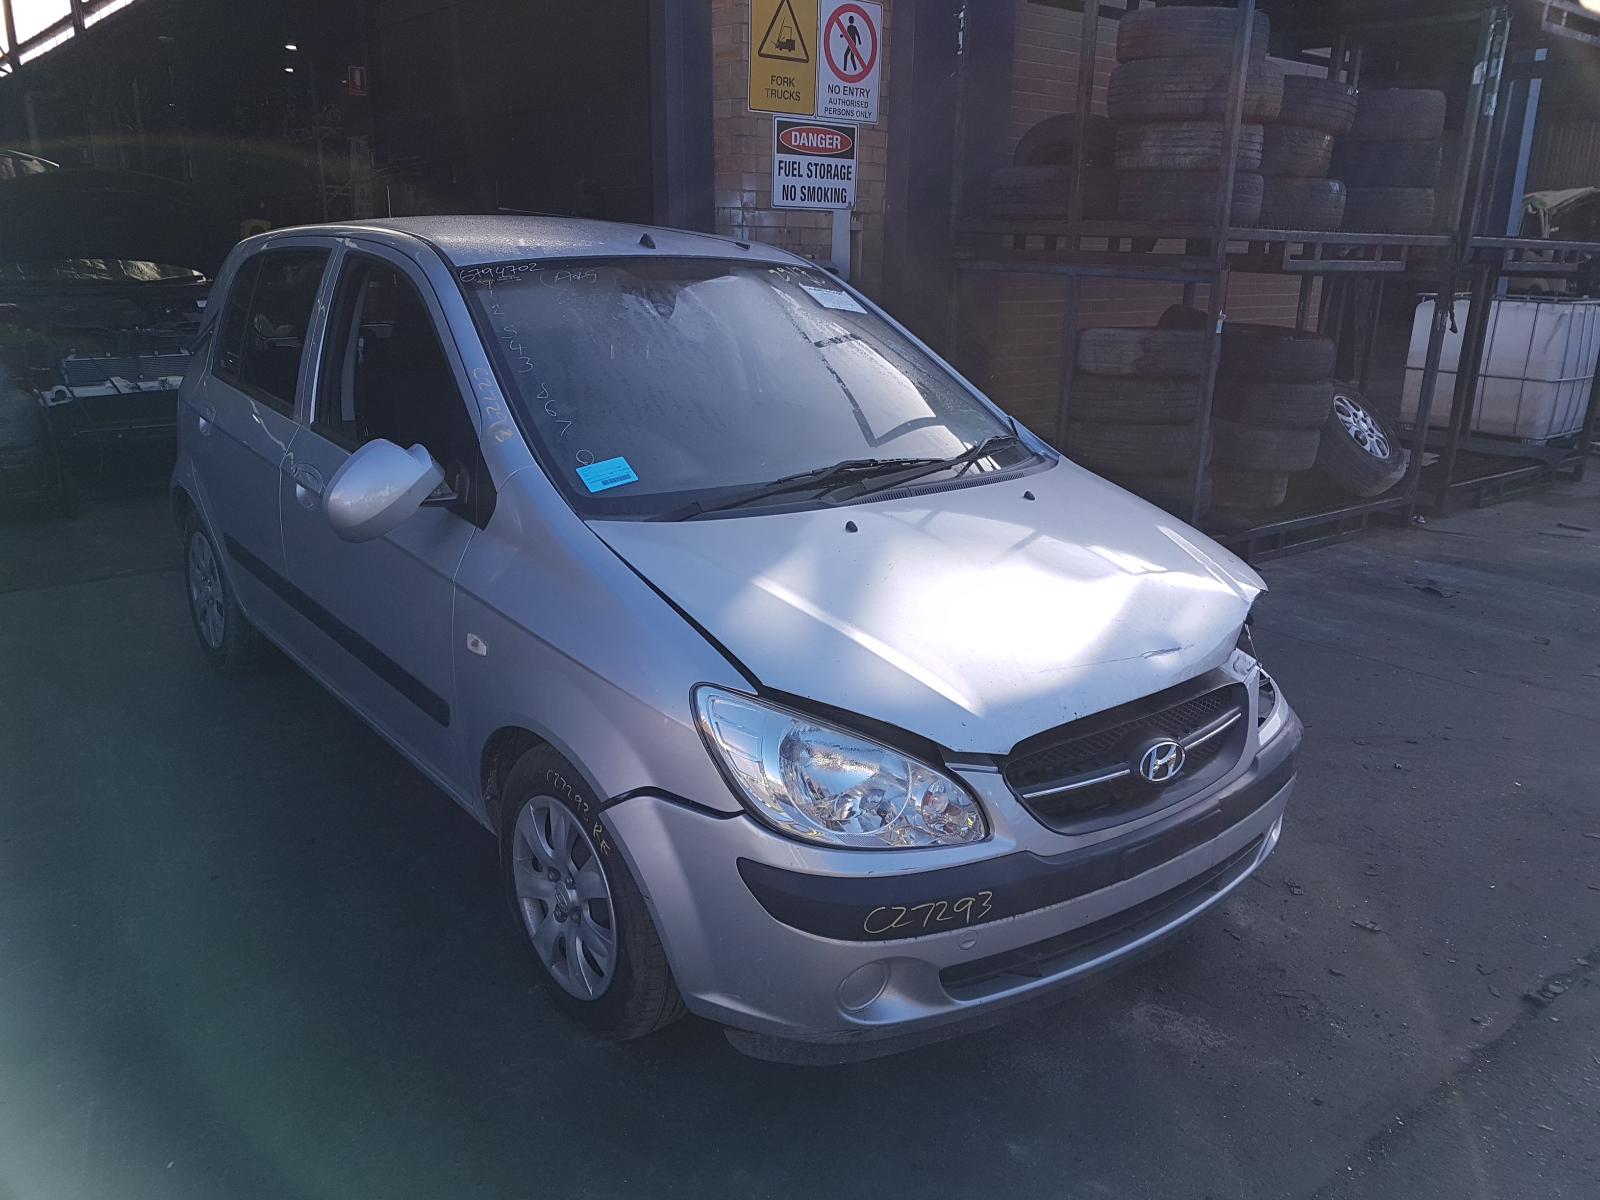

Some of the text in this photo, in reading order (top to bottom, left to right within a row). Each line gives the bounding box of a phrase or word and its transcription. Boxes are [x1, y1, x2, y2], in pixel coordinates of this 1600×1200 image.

[770, 75, 795, 87] FORK
[765, 88, 801, 101] TRUCKS
[828, 84, 870, 98] NO ENTRY
[828, 97, 869, 108] AUTHORISED
[824, 107, 872, 119] PERSONS ONLY
[791, 131, 841, 149] DANGER
[778, 160, 852, 180] FUEL STORAGE
[782, 185, 847, 204] NO SMOKING
